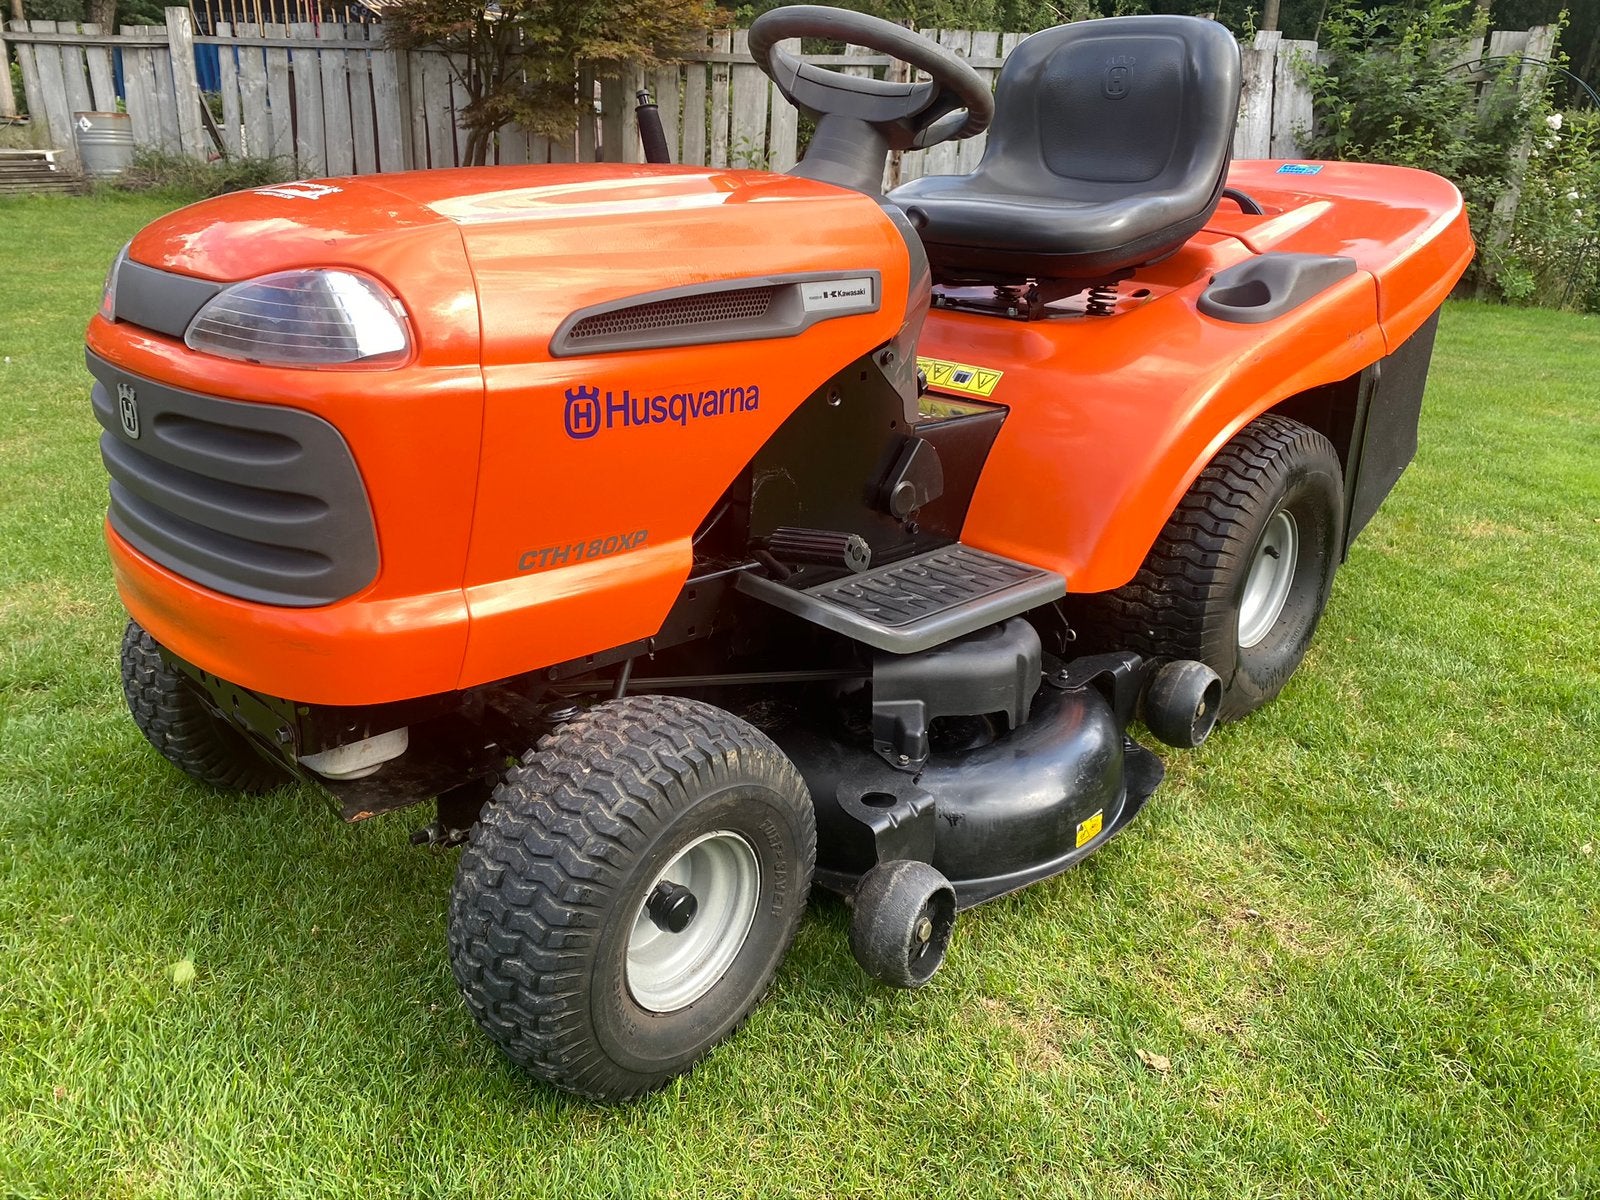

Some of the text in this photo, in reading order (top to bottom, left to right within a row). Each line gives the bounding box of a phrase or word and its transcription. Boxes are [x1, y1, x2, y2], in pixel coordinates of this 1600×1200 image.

[837, 282, 866, 298] Kawasaki
[605, 385, 760, 428] Husqvarna
[518, 529, 649, 571] CTH180XP
